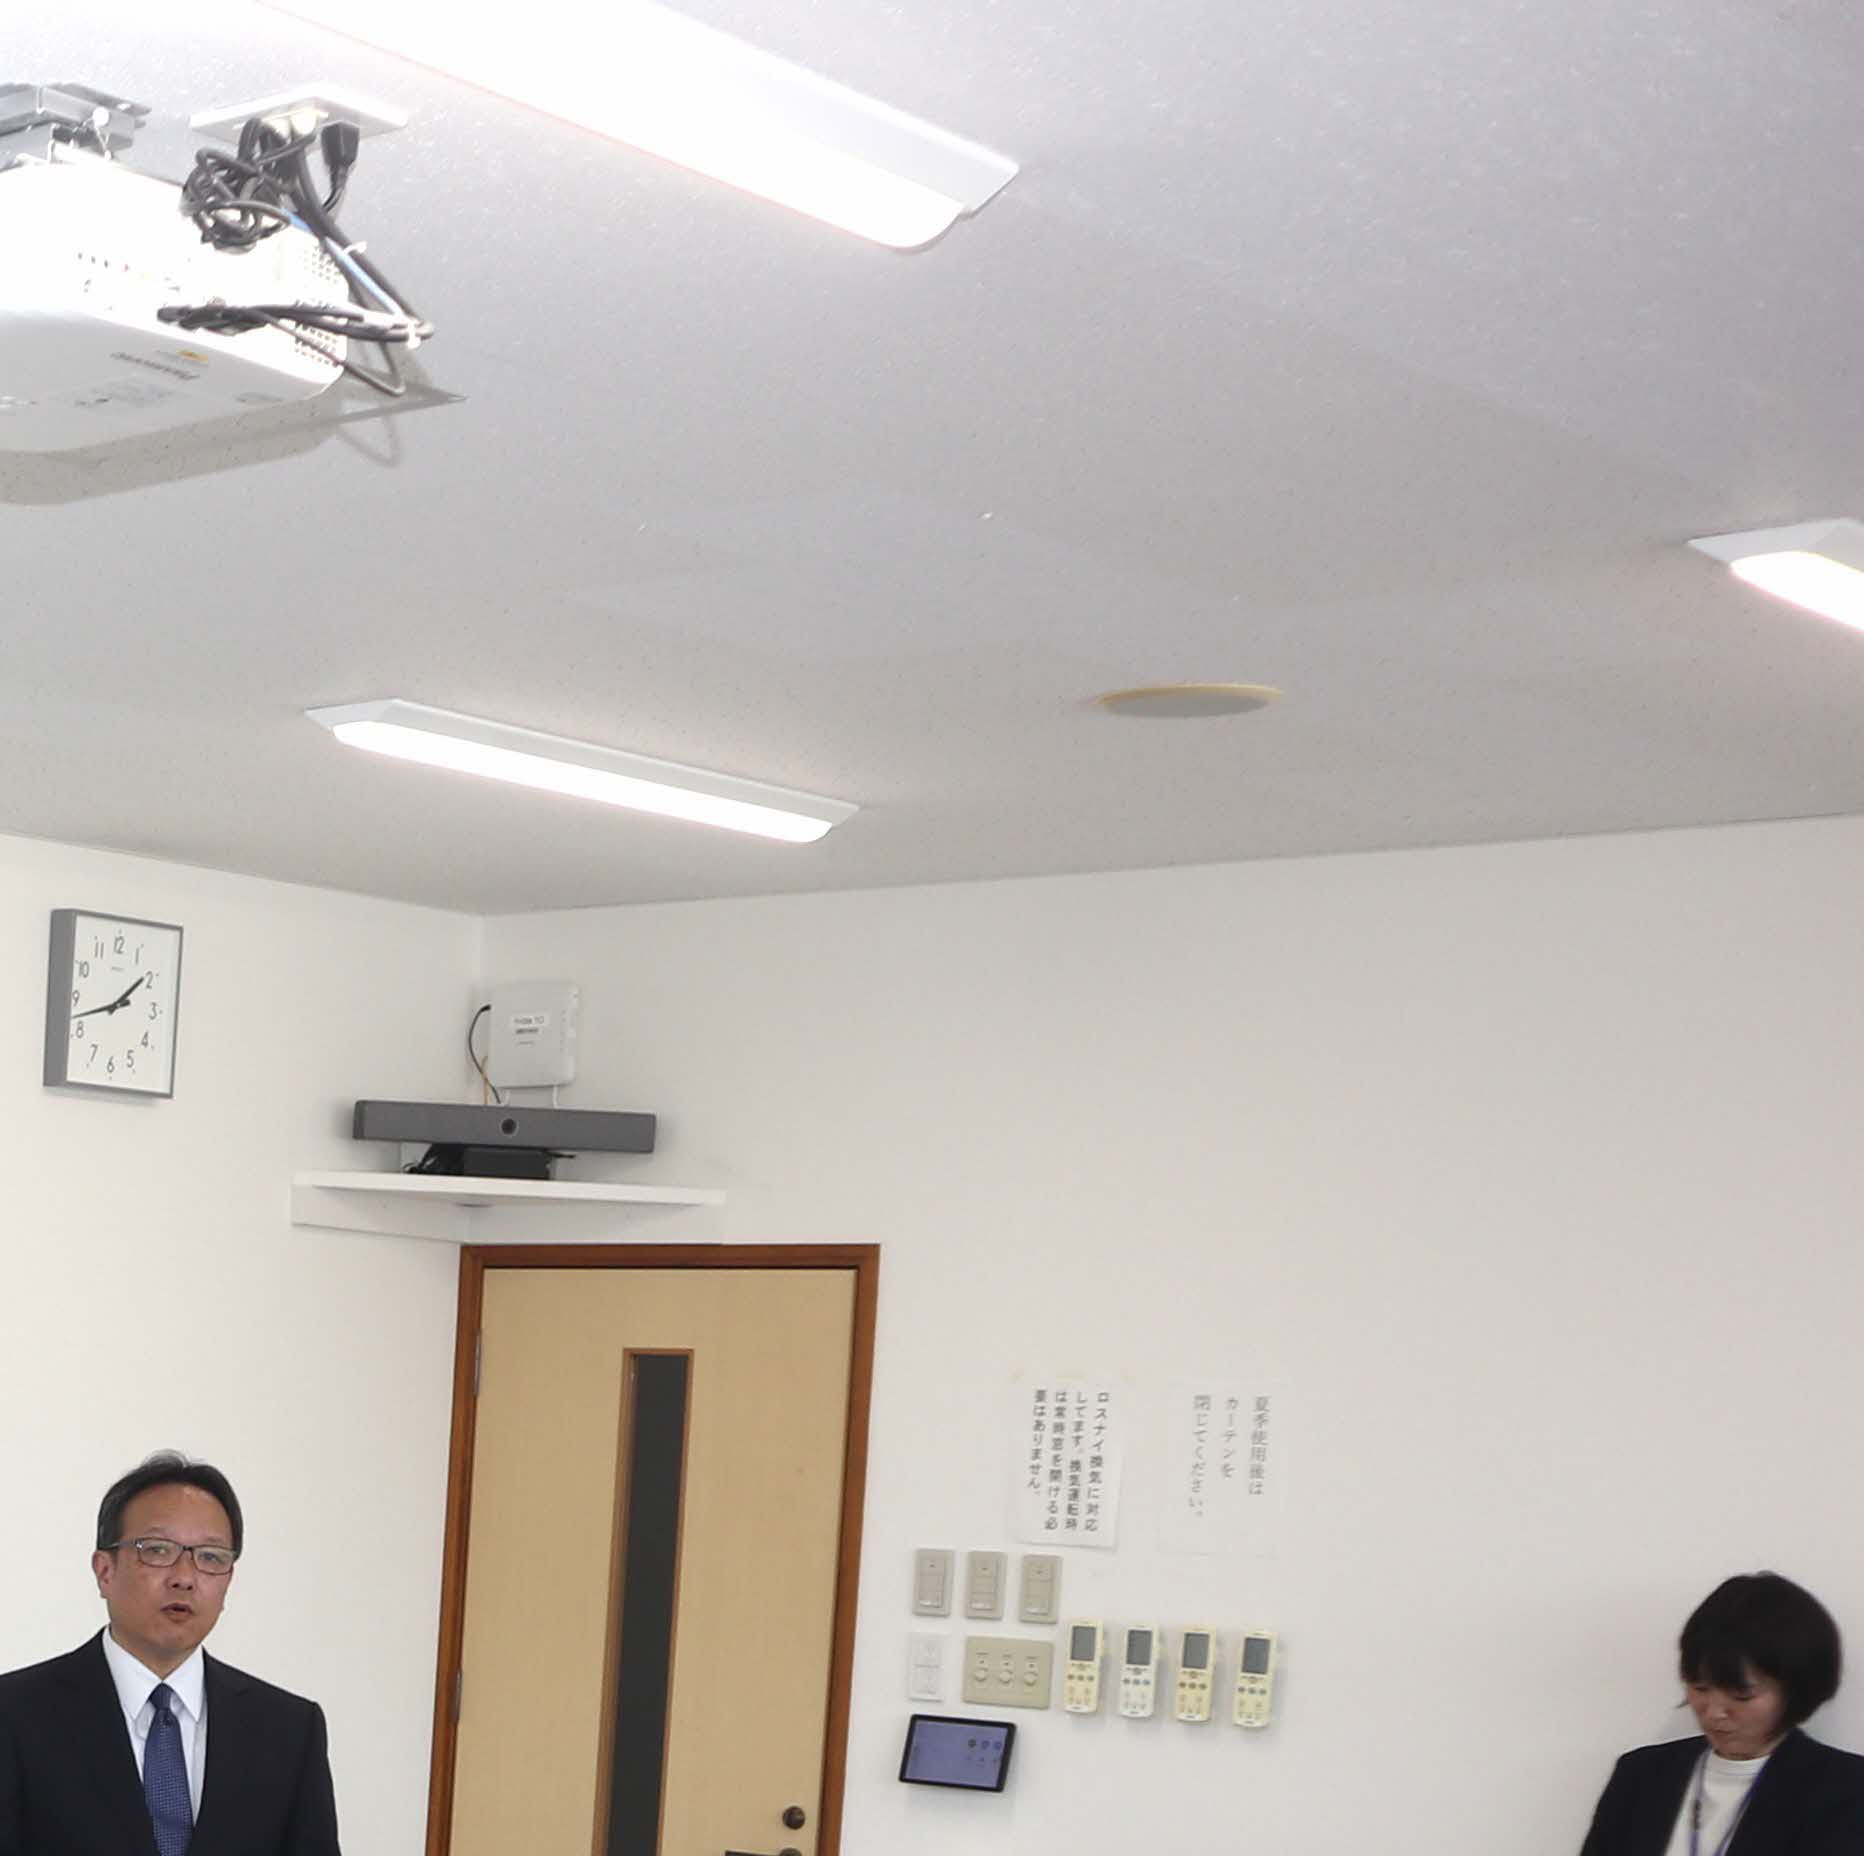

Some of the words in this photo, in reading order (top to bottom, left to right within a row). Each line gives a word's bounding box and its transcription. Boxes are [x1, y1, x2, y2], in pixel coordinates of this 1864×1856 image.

[95, 942, 104, 959] 11
[114, 935, 125, 954] 12
[135, 947, 140, 965] 1
[78, 961, 89, 978] 10
[145, 971, 153, 989] 2
[72, 990, 80, 1007] 9
[148, 1002, 157, 1020] 3
[76, 1021, 84, 1039] 8
[141, 1031, 149, 1048] 4
[90, 1044, 98, 1062] 7
[126, 1050, 134, 1068] 5
[107, 1056, 114, 1073] 6
